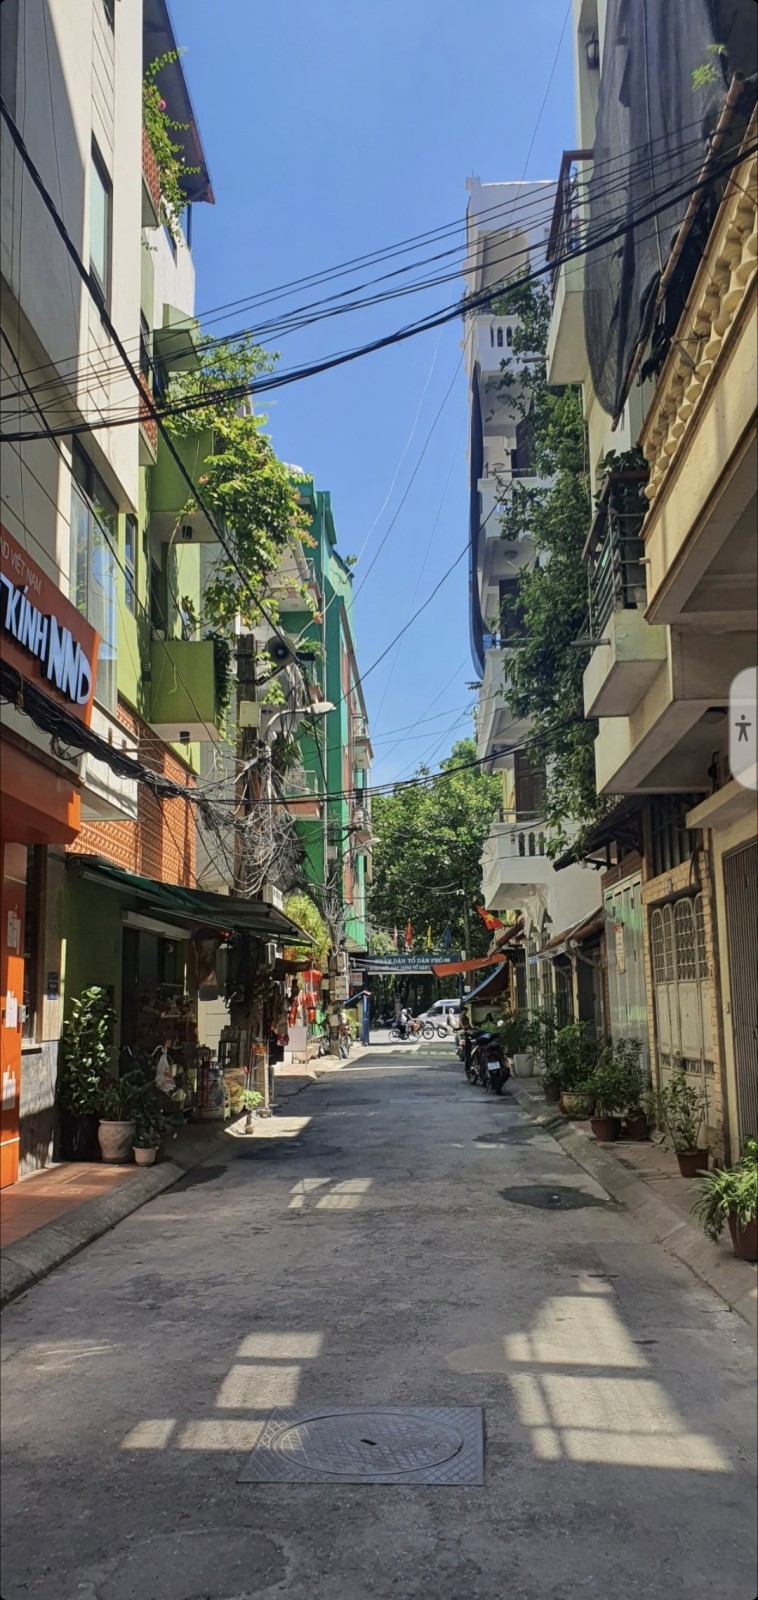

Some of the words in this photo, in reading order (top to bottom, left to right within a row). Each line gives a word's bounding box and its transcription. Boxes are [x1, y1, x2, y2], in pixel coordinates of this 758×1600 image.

[26, 566, 42, 596] NAM
[5, 585, 48, 661] KÍNH
[47, 614, 92, 705] NND
